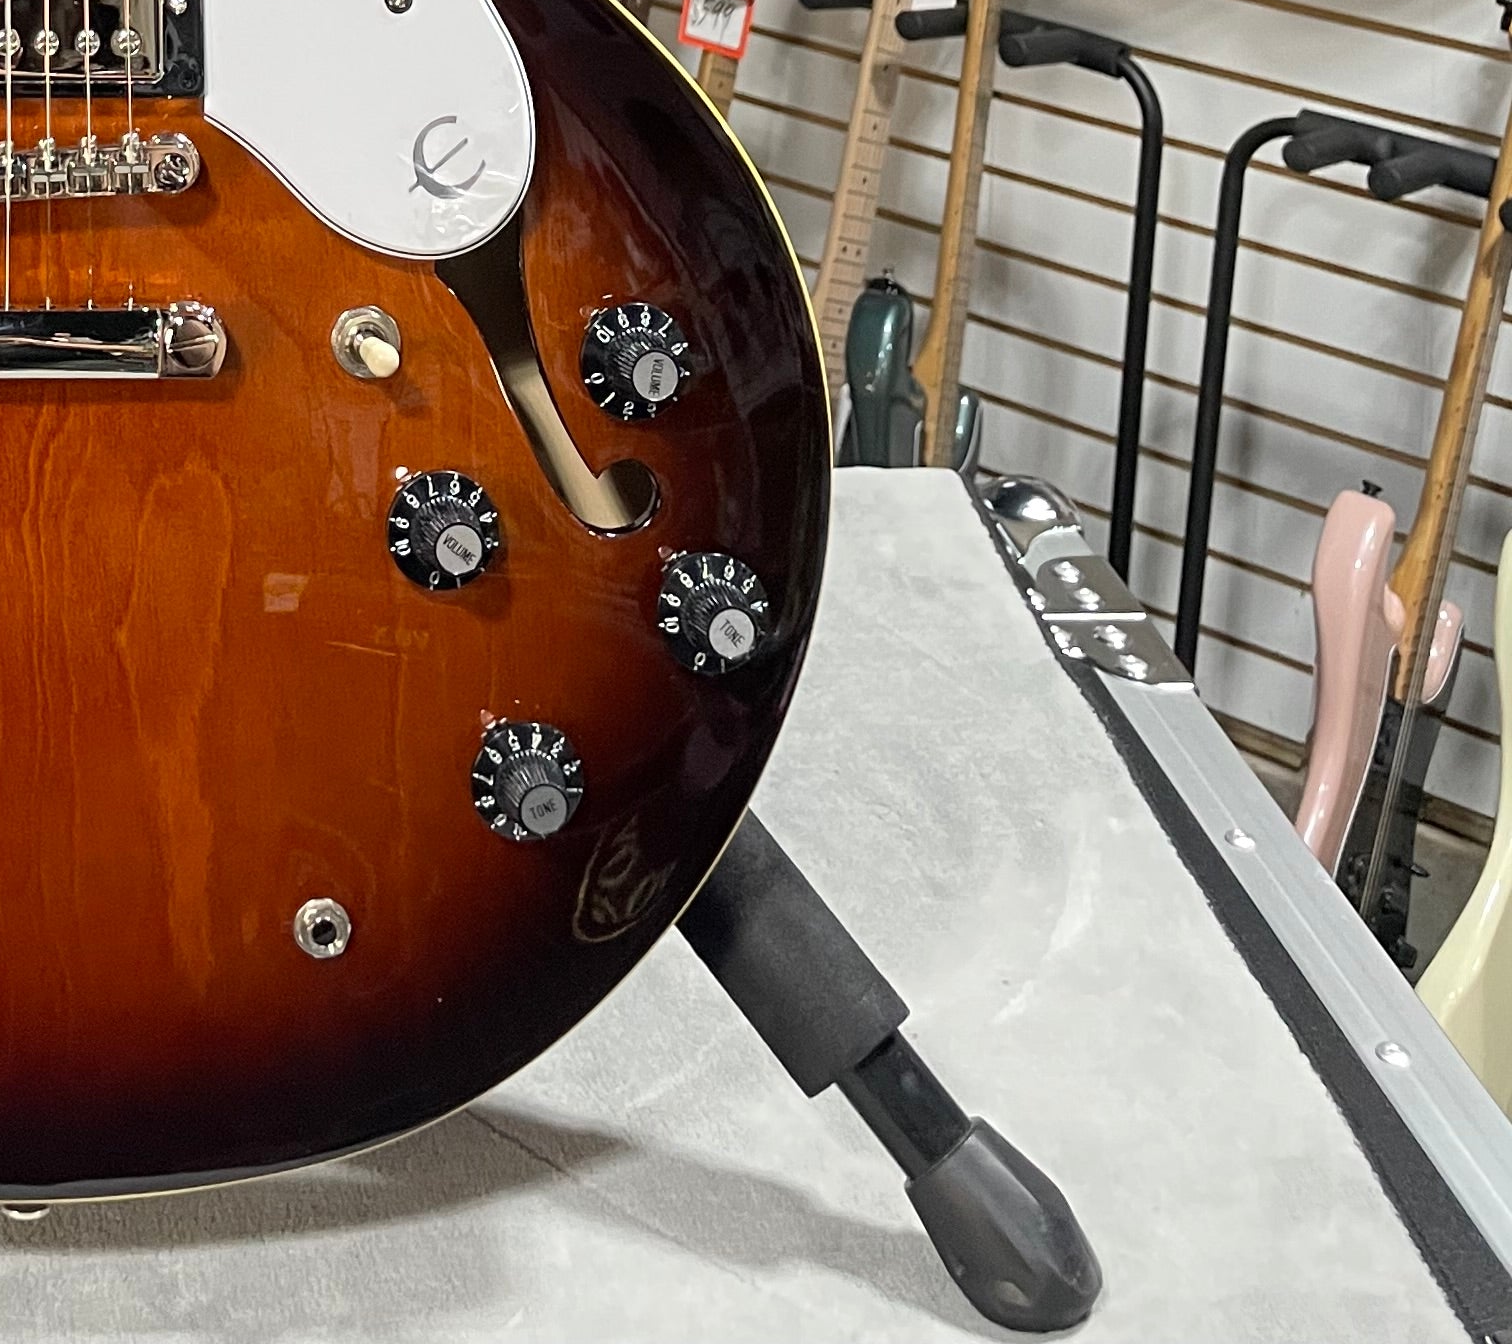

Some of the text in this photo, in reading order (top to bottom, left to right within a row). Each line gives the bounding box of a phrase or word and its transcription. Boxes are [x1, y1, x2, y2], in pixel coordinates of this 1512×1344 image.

[596, 324, 615, 344] 10
[648, 358, 664, 397] VOLUME
[394, 538, 411, 556] 10
[442, 533, 477, 566] VOLUME
[664, 616, 680, 633] 10
[719, 618, 745, 649] TONE
[529, 798, 557, 820] TONE
